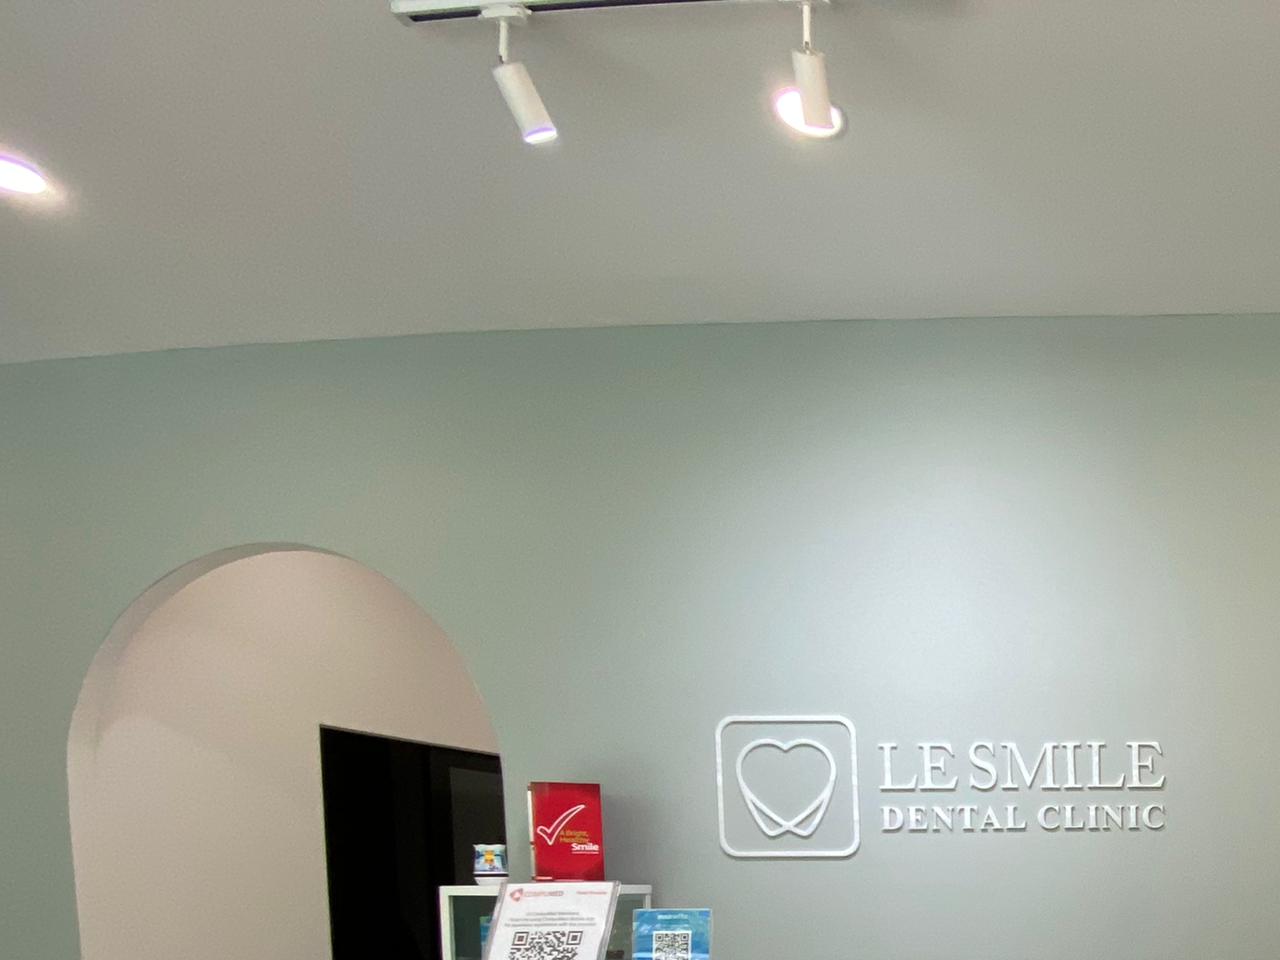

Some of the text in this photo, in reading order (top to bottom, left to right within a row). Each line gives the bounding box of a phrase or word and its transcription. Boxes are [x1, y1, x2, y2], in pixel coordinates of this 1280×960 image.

[878, 741, 1168, 792] LE SMILE
[881, 804, 1167, 833] DENTAL CLINIC
[571, 842, 599, 850] Smile
